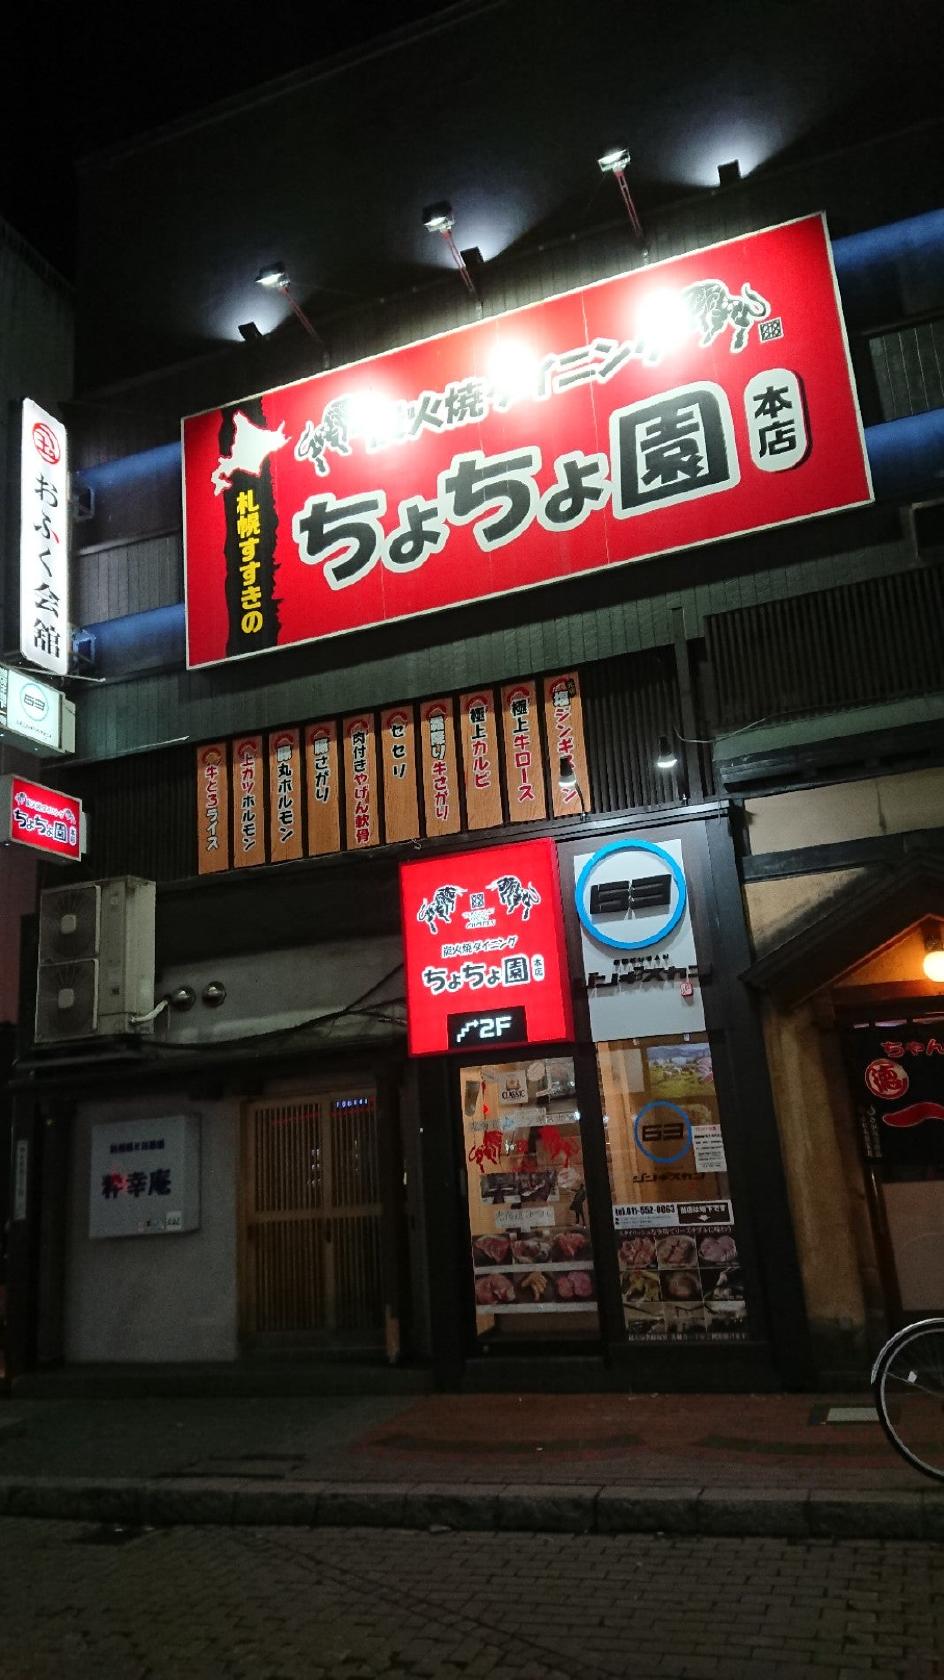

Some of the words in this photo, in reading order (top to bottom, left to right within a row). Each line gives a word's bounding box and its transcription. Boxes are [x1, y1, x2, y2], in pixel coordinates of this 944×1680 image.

[367, 334, 668, 450] 火焼イニン
[754, 385, 797, 457] 本店
[298, 391, 717, 584] ちょちょ園
[34, 472, 61, 659] おふく会館
[236, 488, 264, 634] 札幌すすきの
[351, 730, 371, 843] 肉付きやげん軟骨
[390, 723, 408, 778] セセリ
[469, 706, 491, 788] 極上カルビ
[510, 698, 535, 801] 極上牛ロース
[14, 808, 67, 842] ちょちょ園
[204, 763, 220, 851] 牛とろライス
[423, 956, 529, 991] ちょちょ園
[478, 1016, 513, 1039] 2F
